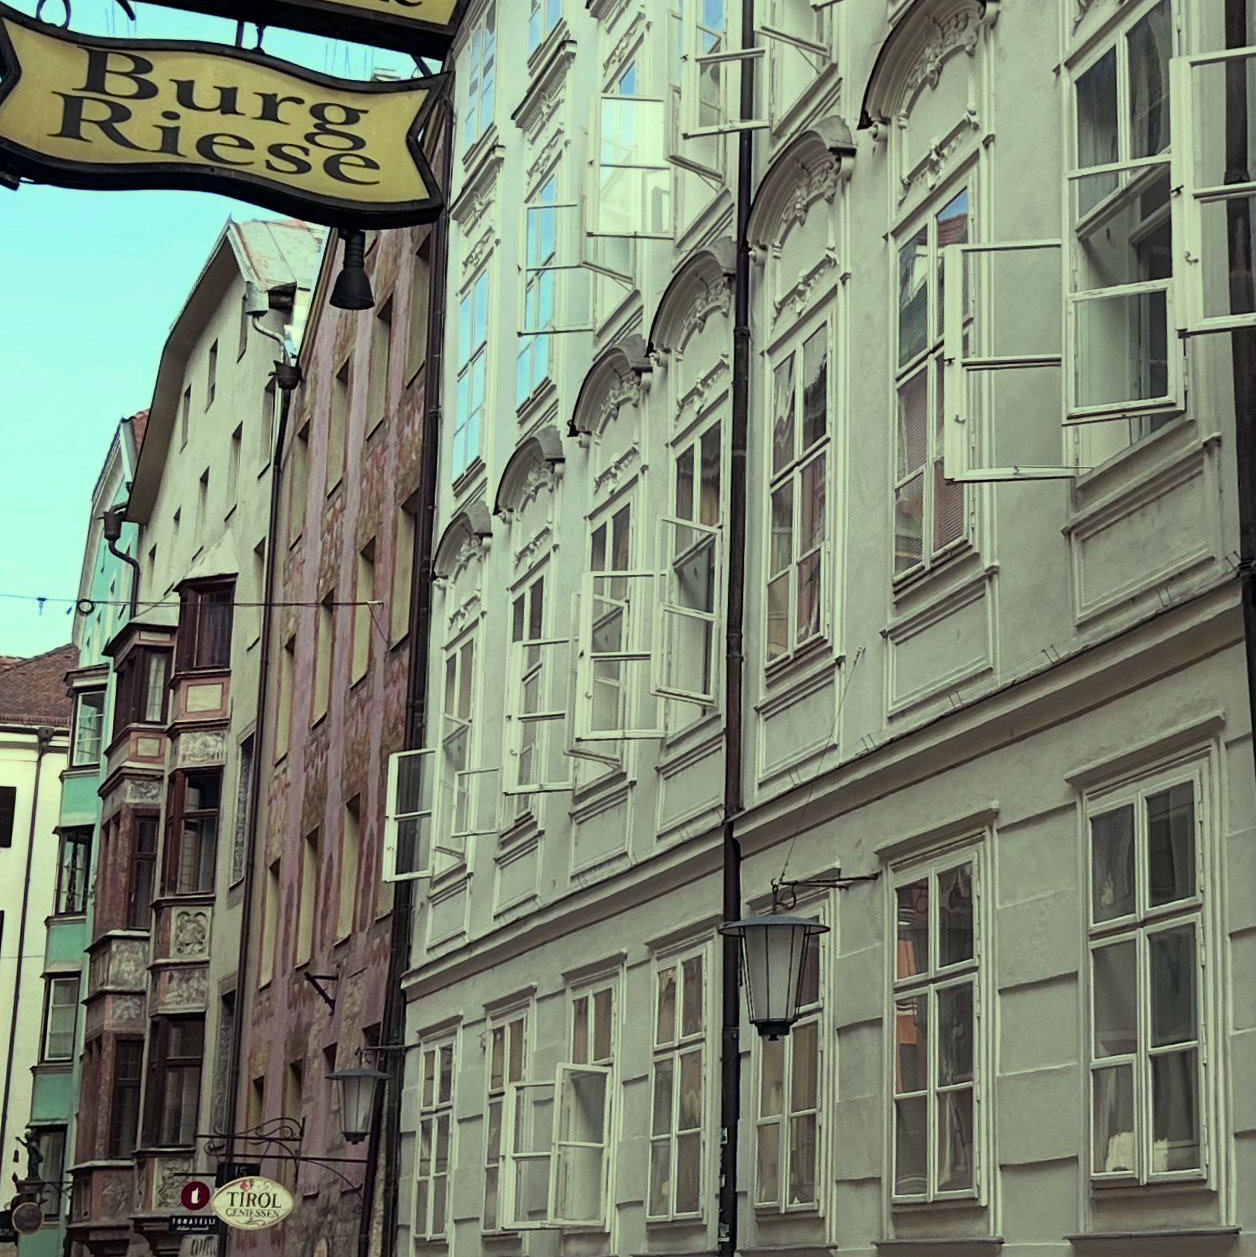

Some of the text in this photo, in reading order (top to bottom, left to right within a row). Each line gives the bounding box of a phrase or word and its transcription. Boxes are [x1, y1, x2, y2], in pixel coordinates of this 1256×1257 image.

[47, 91, 381, 186] Riese
[73, 46, 370, 151] Burg
[226, 1191, 282, 1209] TIROL
